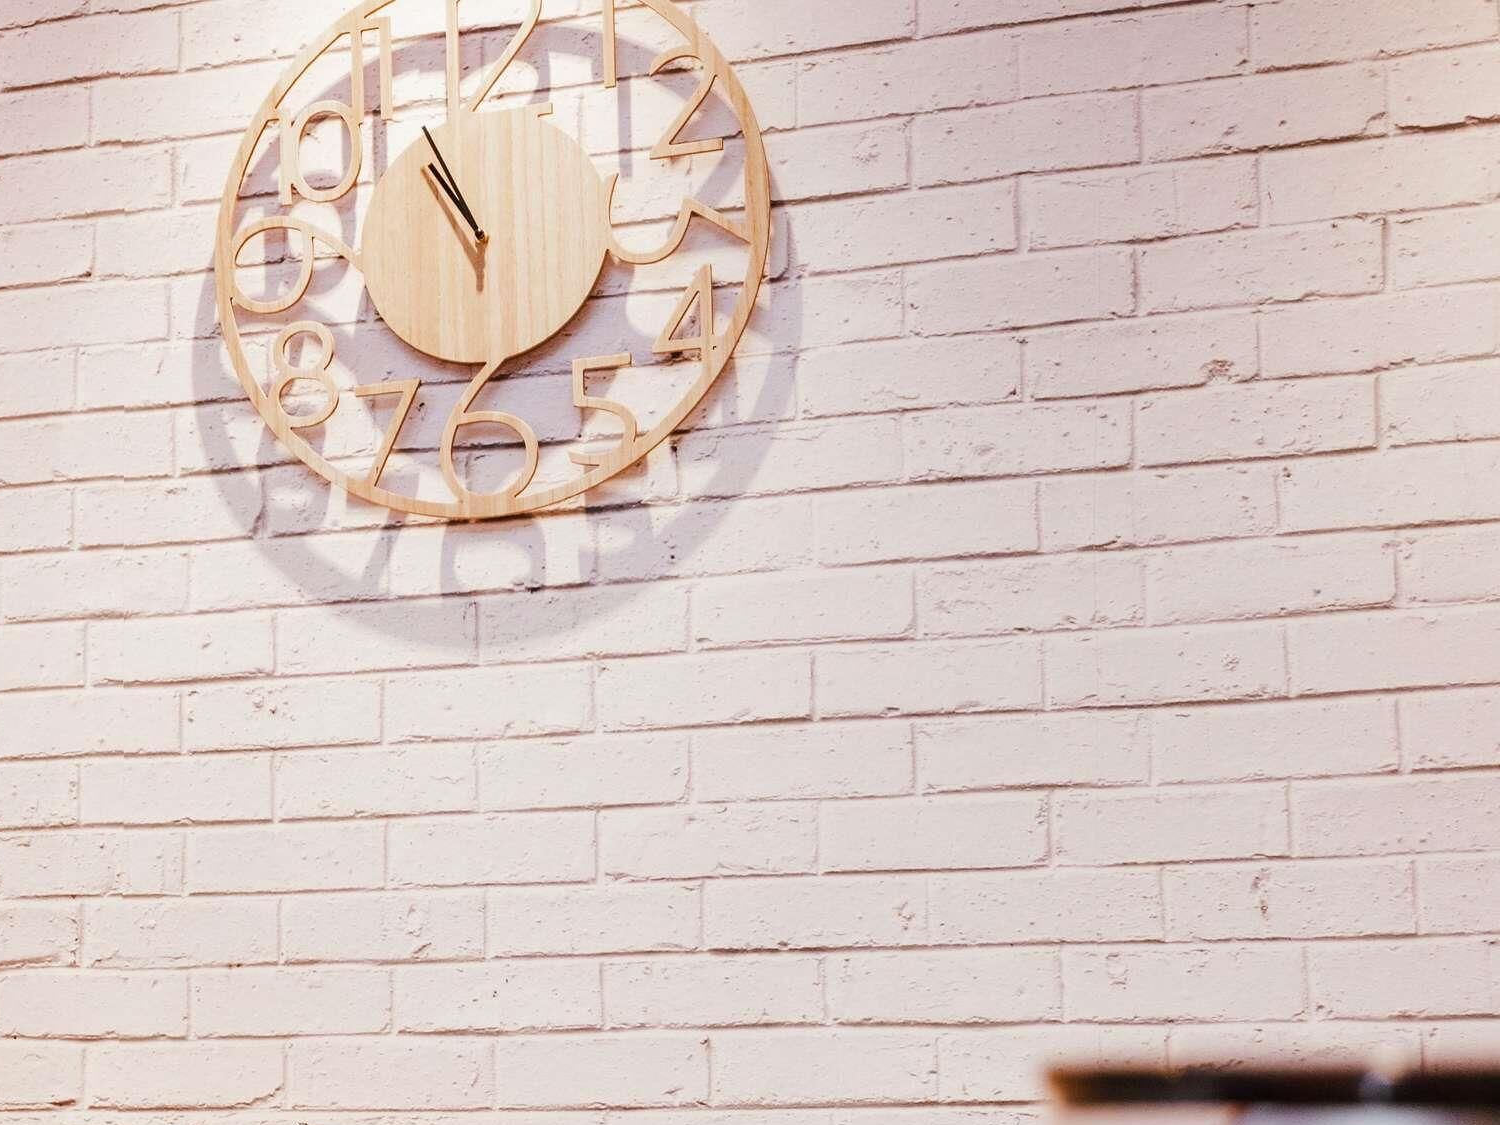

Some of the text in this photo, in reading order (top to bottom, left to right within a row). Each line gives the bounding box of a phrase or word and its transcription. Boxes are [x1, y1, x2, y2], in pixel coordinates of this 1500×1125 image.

[446, 0, 553, 118] 12
[649, 51, 724, 160] 2
[265, 100, 363, 206] 10
[230, 215, 365, 314] 9
[607, 172, 752, 265] 3
[651, 264, 718, 356] 4
[272, 320, 340, 430] 8
[440, 357, 540, 502] 6
[569, 352, 639, 468] 5
[355, 378, 422, 490] 7
